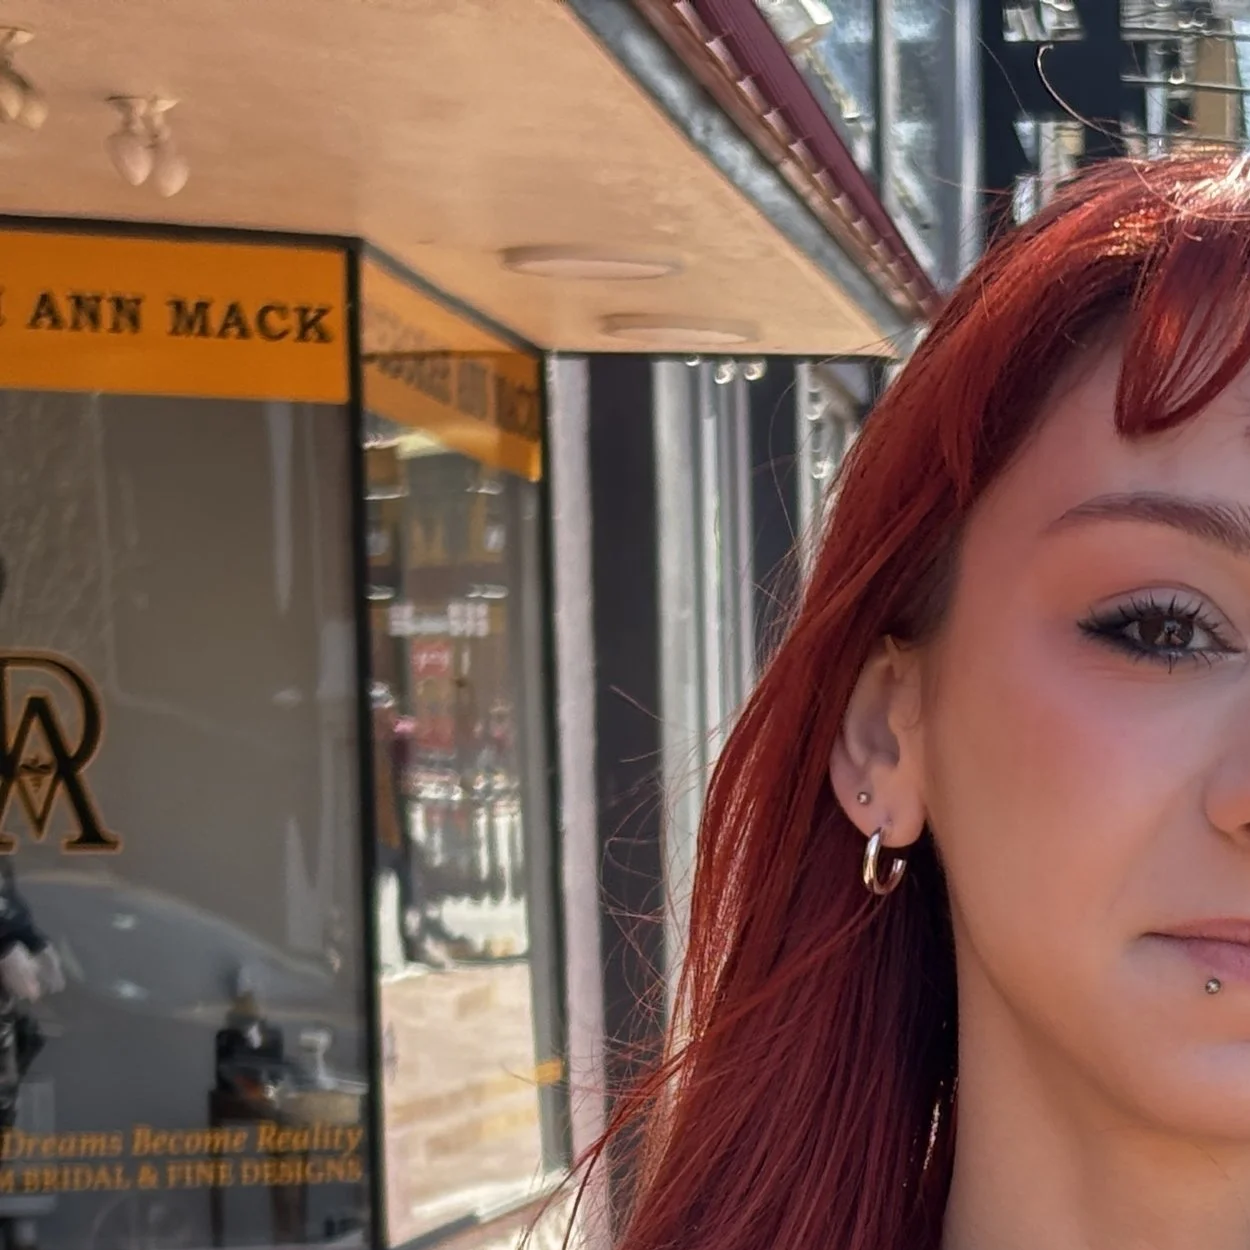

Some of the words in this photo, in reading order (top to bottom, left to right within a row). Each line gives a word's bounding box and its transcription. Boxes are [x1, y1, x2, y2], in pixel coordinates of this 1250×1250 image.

[26, 289, 143, 334] ANN
[165, 298, 334, 344] MACK
[1, 1129, 122, 1160] Dreams
[131, 1123, 247, 1158] Become
[257, 1118, 363, 1158] Reality
[22, 1163, 131, 1192] BRIDAL
[138, 1163, 157, 1189] &
[166, 1158, 233, 1188] FINE
[240, 1154, 363, 1186] DESIGNS
